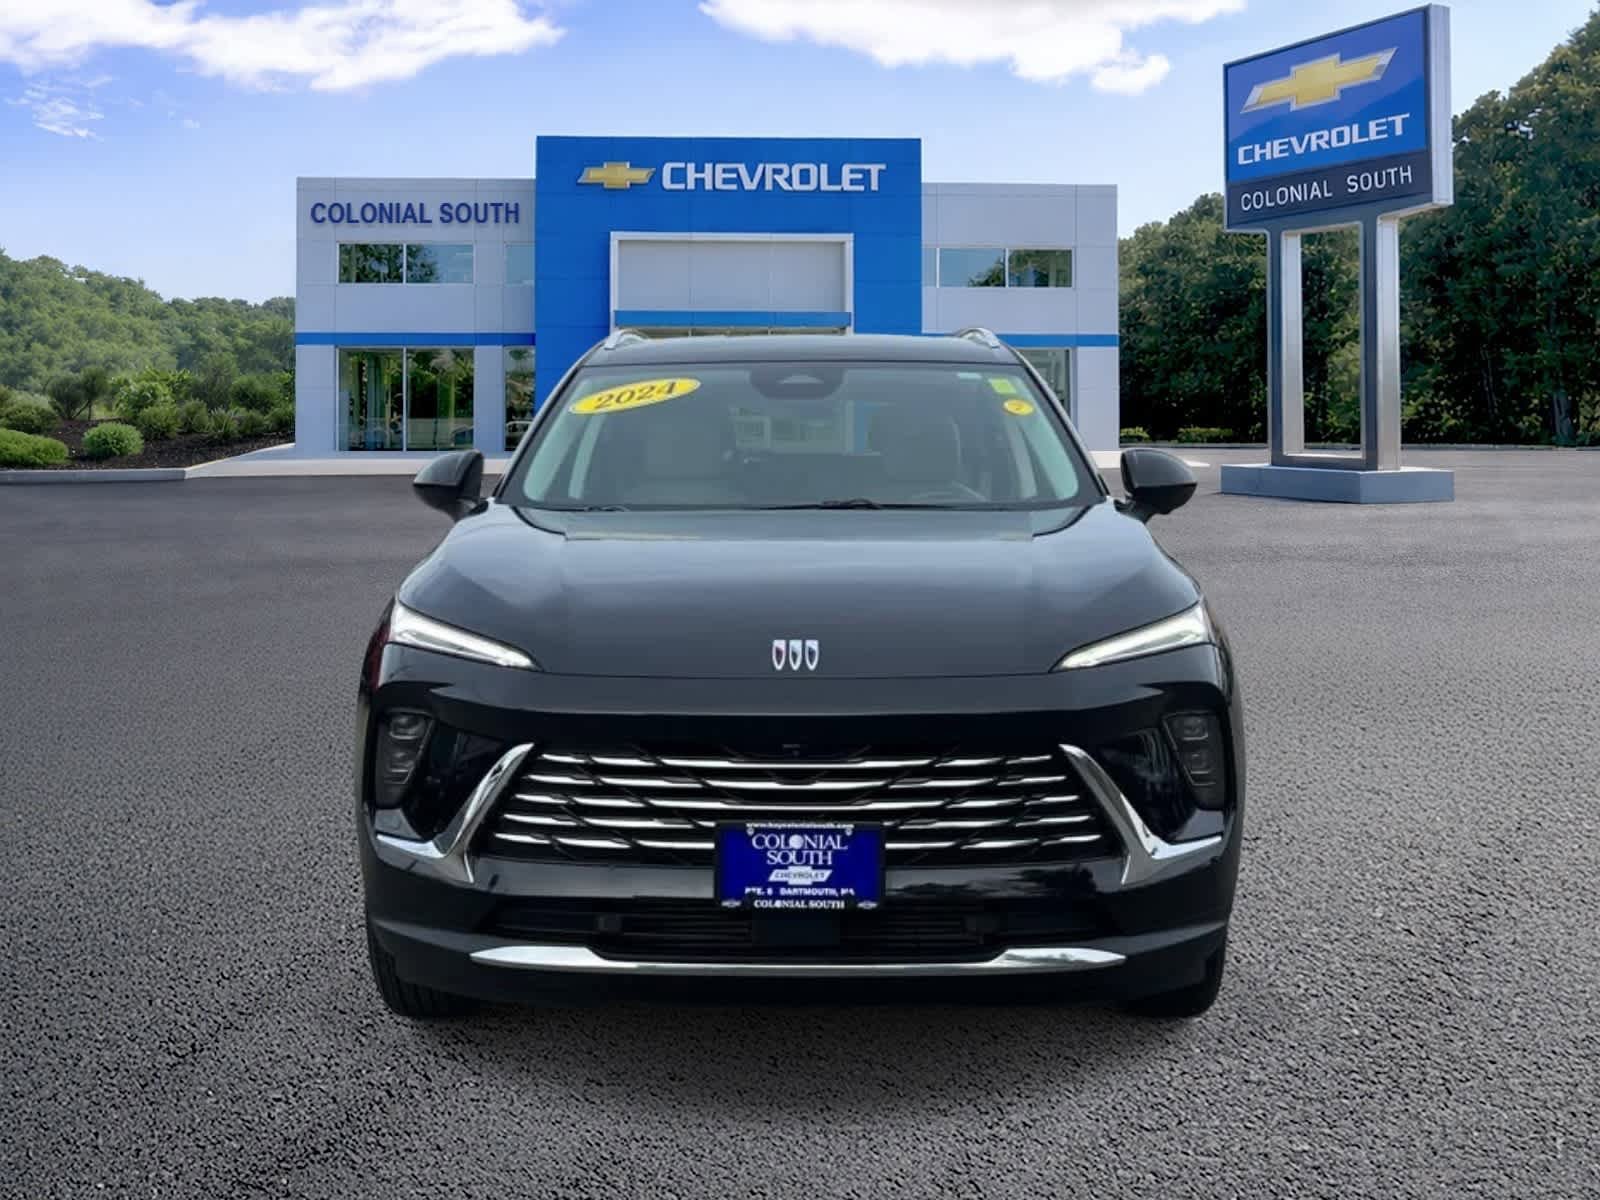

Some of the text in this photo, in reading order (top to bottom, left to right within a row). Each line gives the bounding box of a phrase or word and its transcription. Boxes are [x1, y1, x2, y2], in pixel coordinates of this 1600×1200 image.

[1238, 113, 1410, 165] CHEVROLET
[662, 162, 887, 191] CHEVROLET
[1241, 165, 1413, 211] COLONIAL SOUTH
[310, 202, 520, 224] COLONIAL SOUTH
[594, 382, 677, 409] 2024
[752, 835, 848, 850] COLONIAL
[766, 850, 832, 865] SOUTH
[774, 871, 826, 879] CHEVROLET
[754, 900, 845, 909] COLONIAL SOUTH
